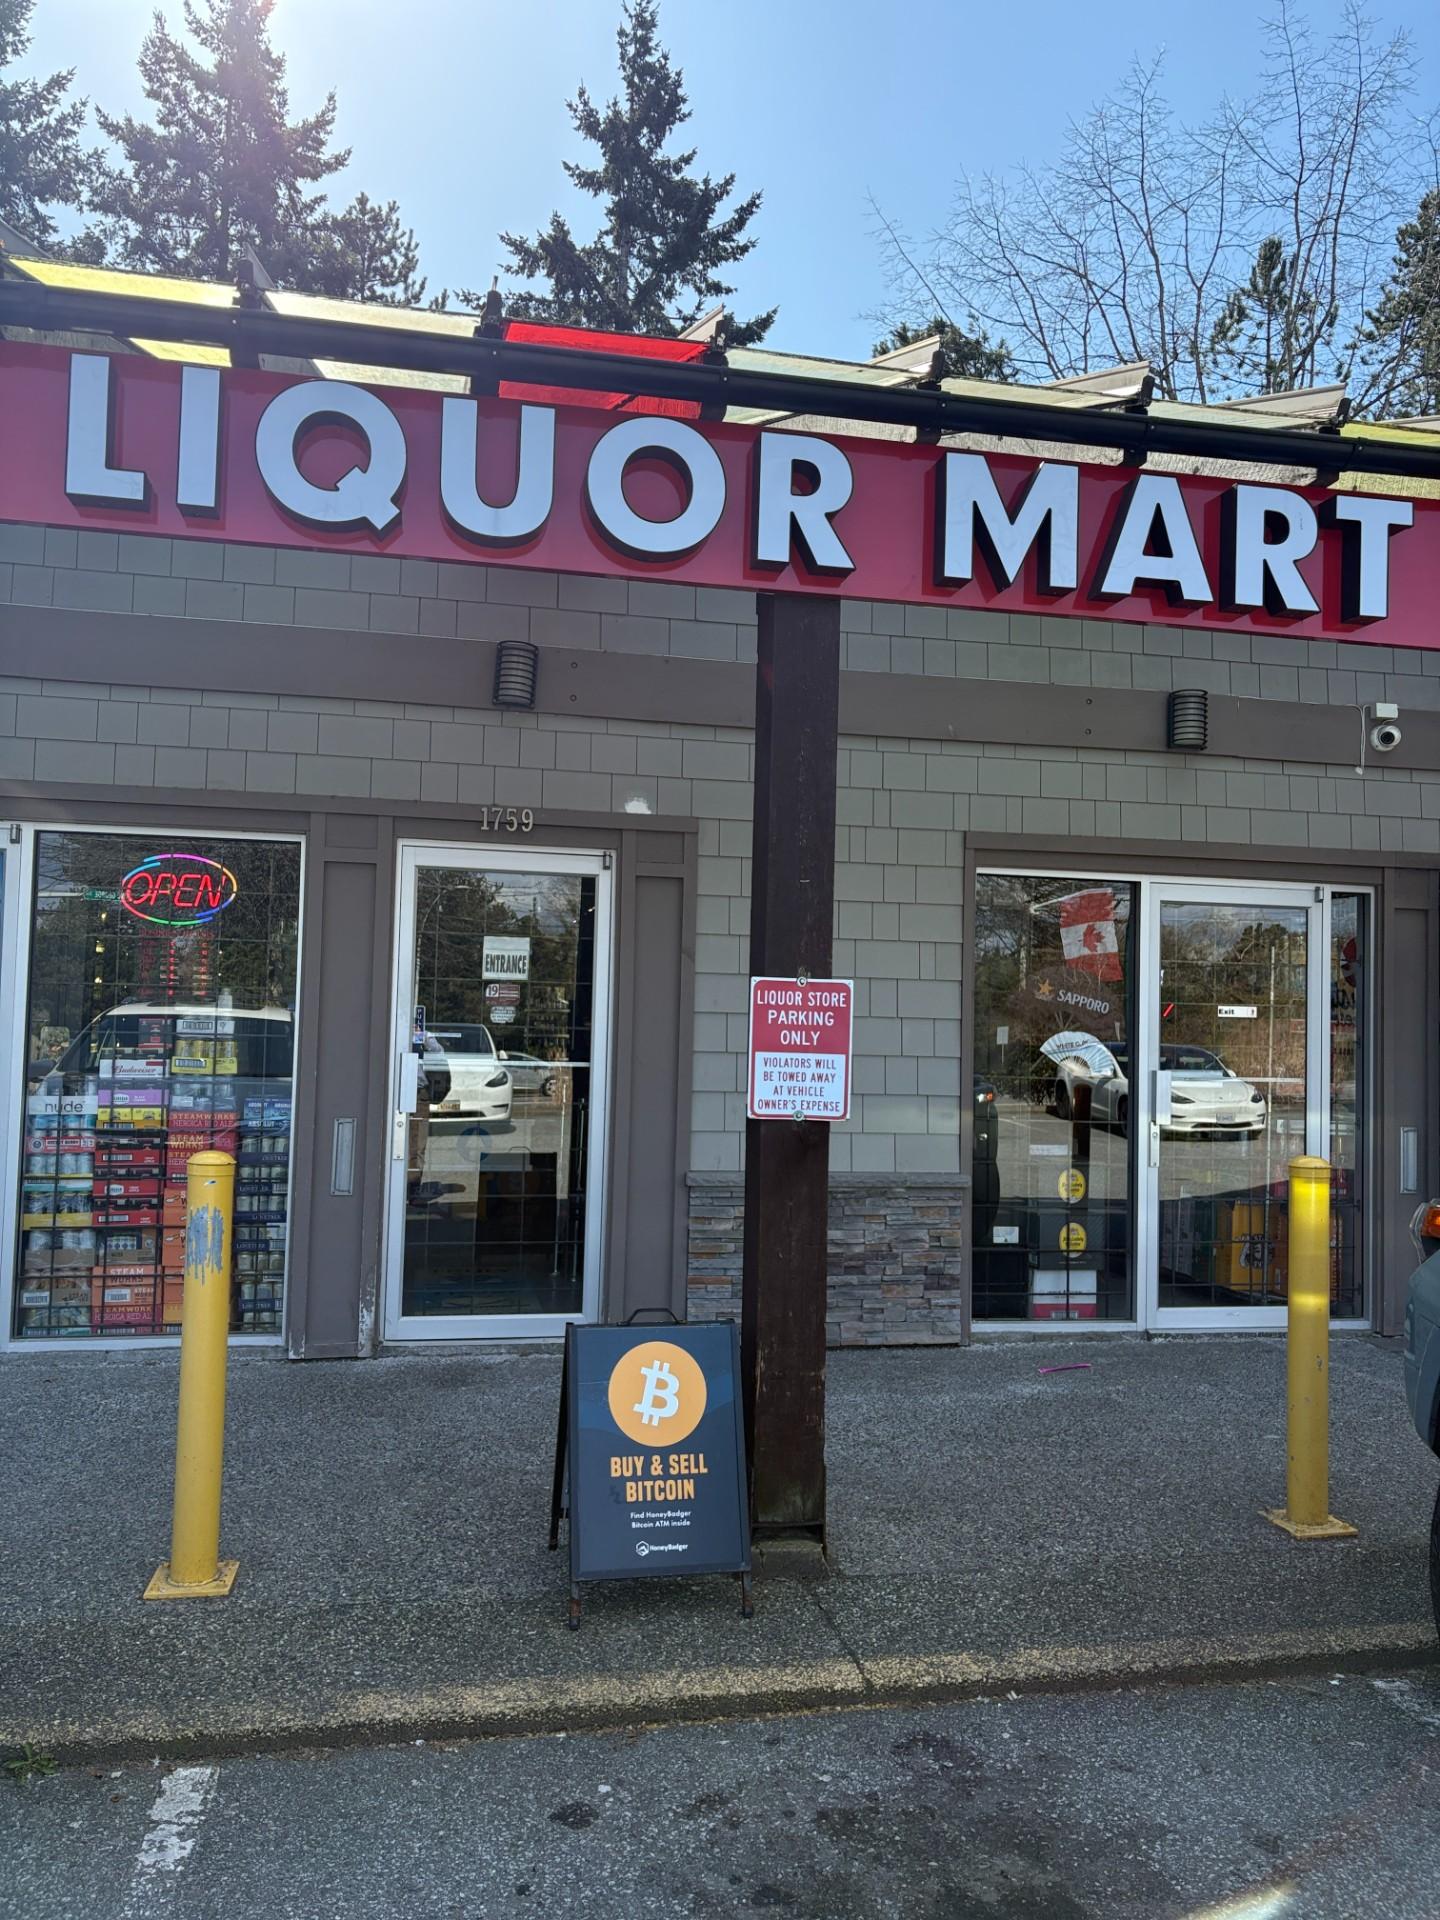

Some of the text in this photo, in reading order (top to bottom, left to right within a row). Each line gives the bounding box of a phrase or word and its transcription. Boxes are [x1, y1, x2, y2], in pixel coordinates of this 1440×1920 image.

[64, 353, 1416, 625] LIQUOR MART
[480, 806, 533, 832] 1759
[126, 872, 227, 908] OPEN
[485, 953, 528, 975] ENTRANCE
[488, 984, 499, 996] 19
[757, 990, 847, 1008] LIQUOR STORE
[1056, 990, 1110, 1014] SAPPORO
[768, 1010, 835, 1026] PARKING
[780, 1030, 820, 1046] ONLY
[763, 1057, 837, 1070] VIOLATORS WILL
[763, 1071, 836, 1083] BE TOWED AWAY
[773, 1085, 824, 1097] AT VEHICLE
[44, 1101, 83, 1113] nude
[757, 1099, 840, 1112] OWNER'S EXPENSE
[170, 1133, 205, 1142] STEAM
[610, 1453, 708, 1478] BUY & SELL
[626, 1478, 695, 1502] BITCOIN
[630, 1509, 691, 1519] Find HoneyBadger
[655, 1520, 670, 1528] ATM
[671, 1519, 691, 1527] inside
[649, 1543, 688, 1552] HoneyBadger
